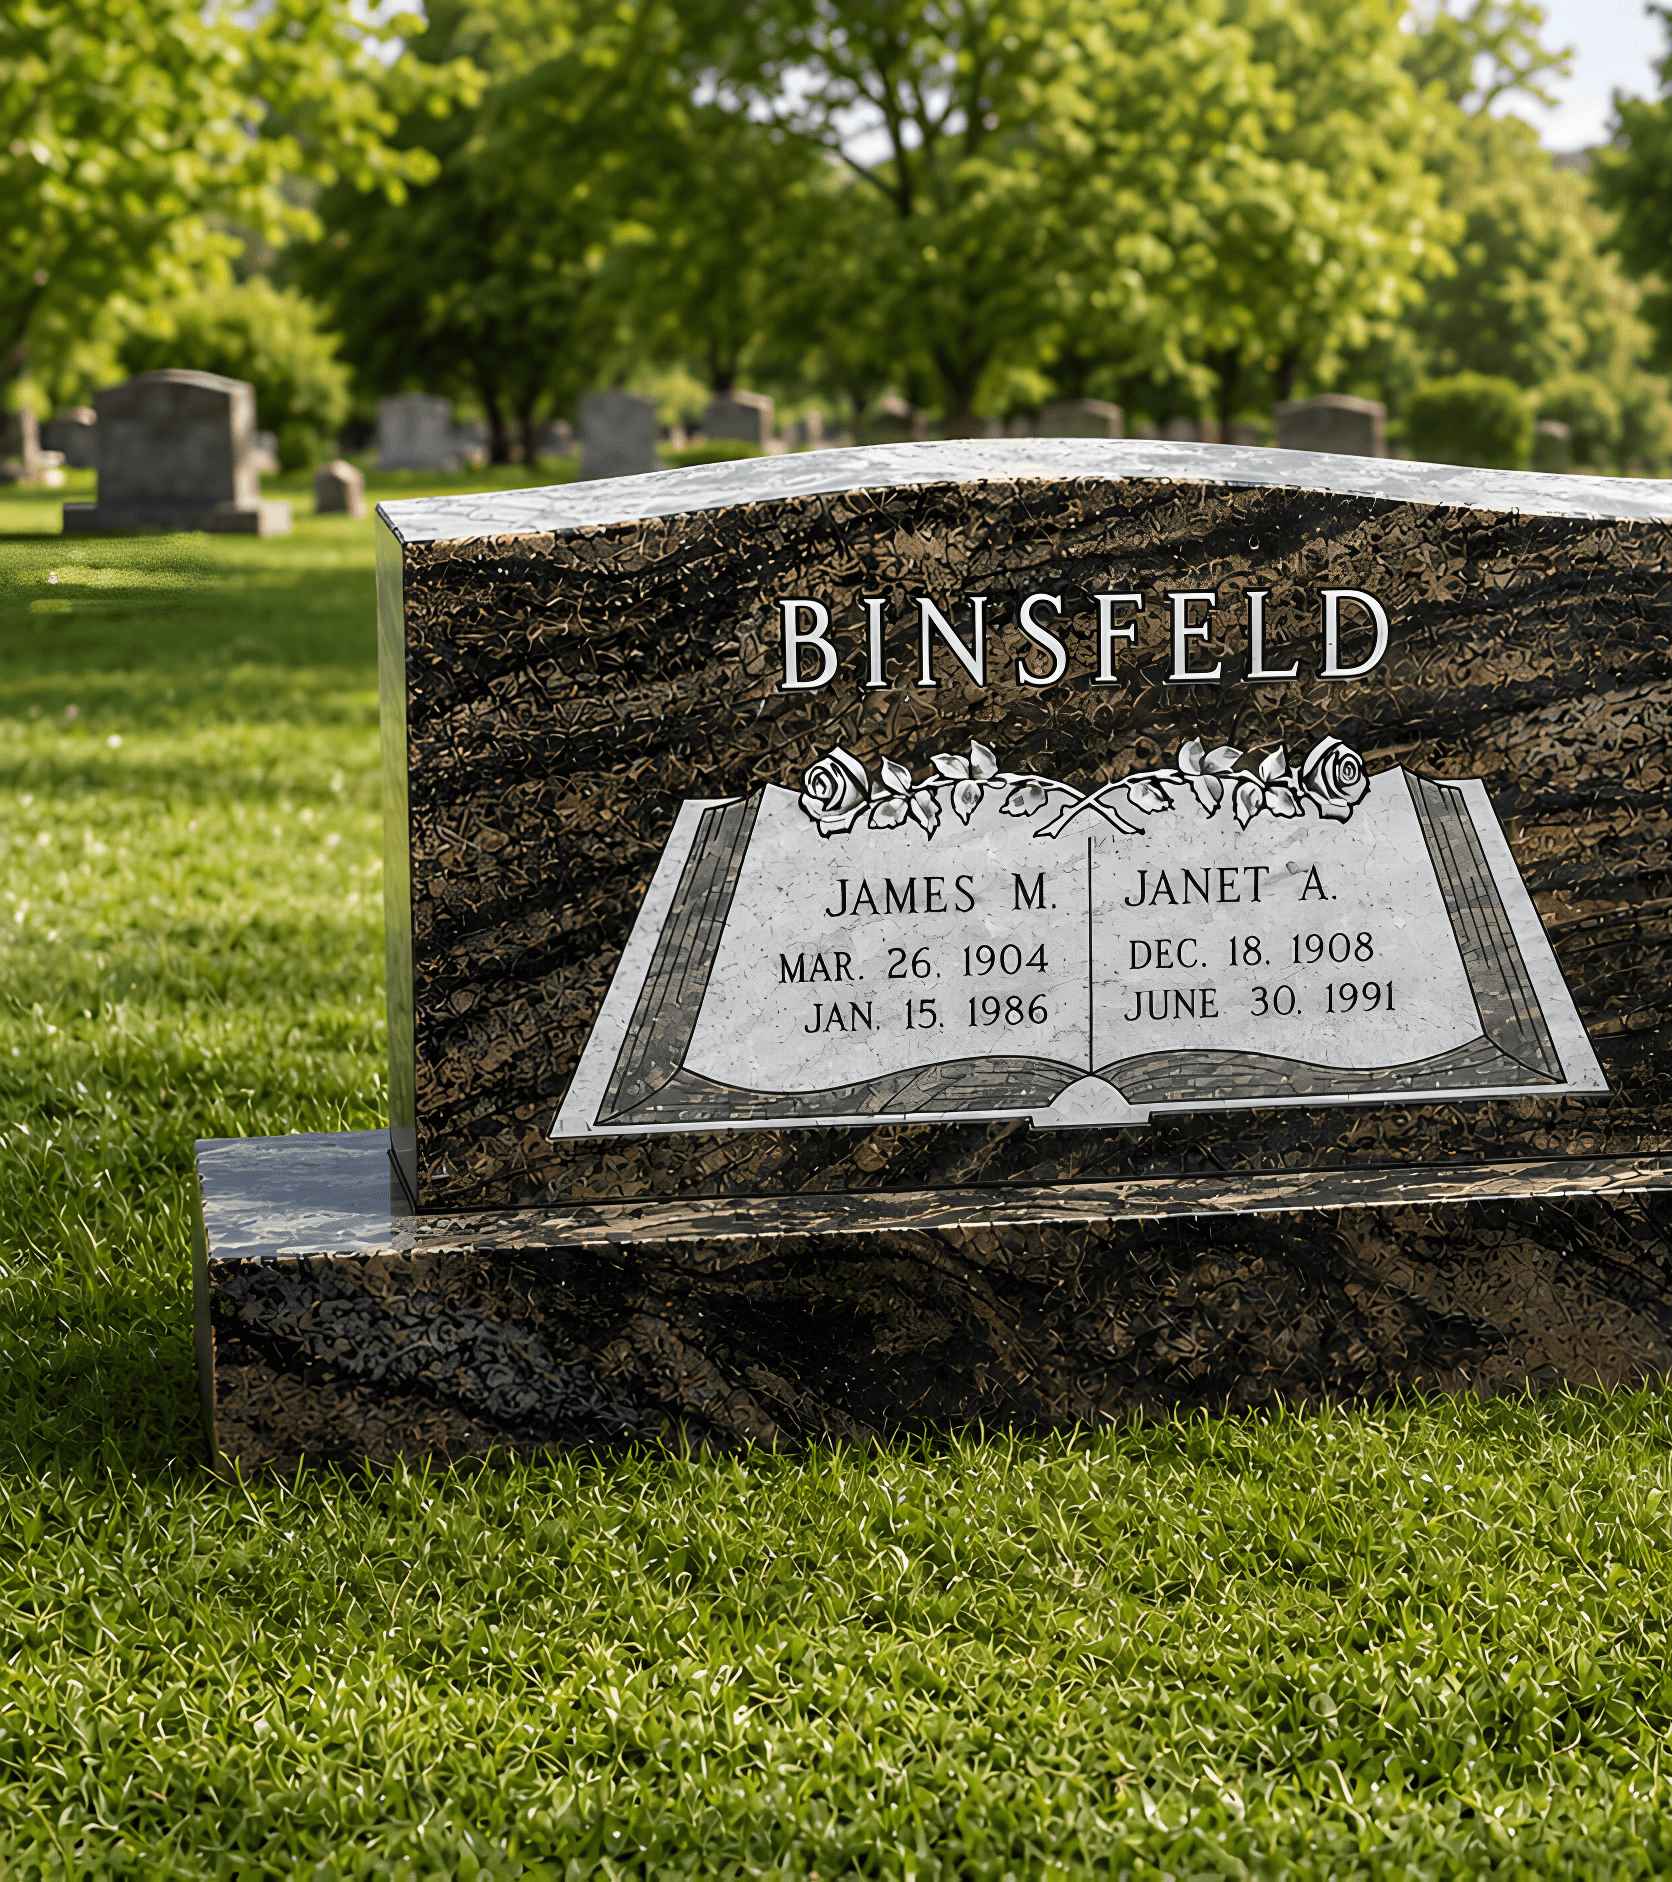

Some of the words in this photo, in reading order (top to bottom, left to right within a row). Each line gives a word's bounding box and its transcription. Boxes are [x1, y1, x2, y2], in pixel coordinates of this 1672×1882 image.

[778, 589, 1390, 689] BINSFELD
[825, 873, 976, 917] JAMES
[1011, 871, 1058, 911] M.
[1124, 866, 1270, 908] JANET
[1300, 863, 1337, 902] A.
[778, 951, 865, 985] MAR.
[887, 947, 941, 981] 26.
[962, 943, 1050, 977] 1904
[1128, 938, 1208, 971] DEC.
[1228, 934, 1271, 967] 18.
[1290, 931, 1375, 965] 1908
[804, 1000, 882, 1035] JAN.
[904, 999, 945, 1031] 15.
[967, 993, 1050, 1028] 1986
[1123, 988, 1221, 1023] JUNE
[1250, 984, 1303, 1018] 30.
[1324, 980, 1396, 1015] 1991
